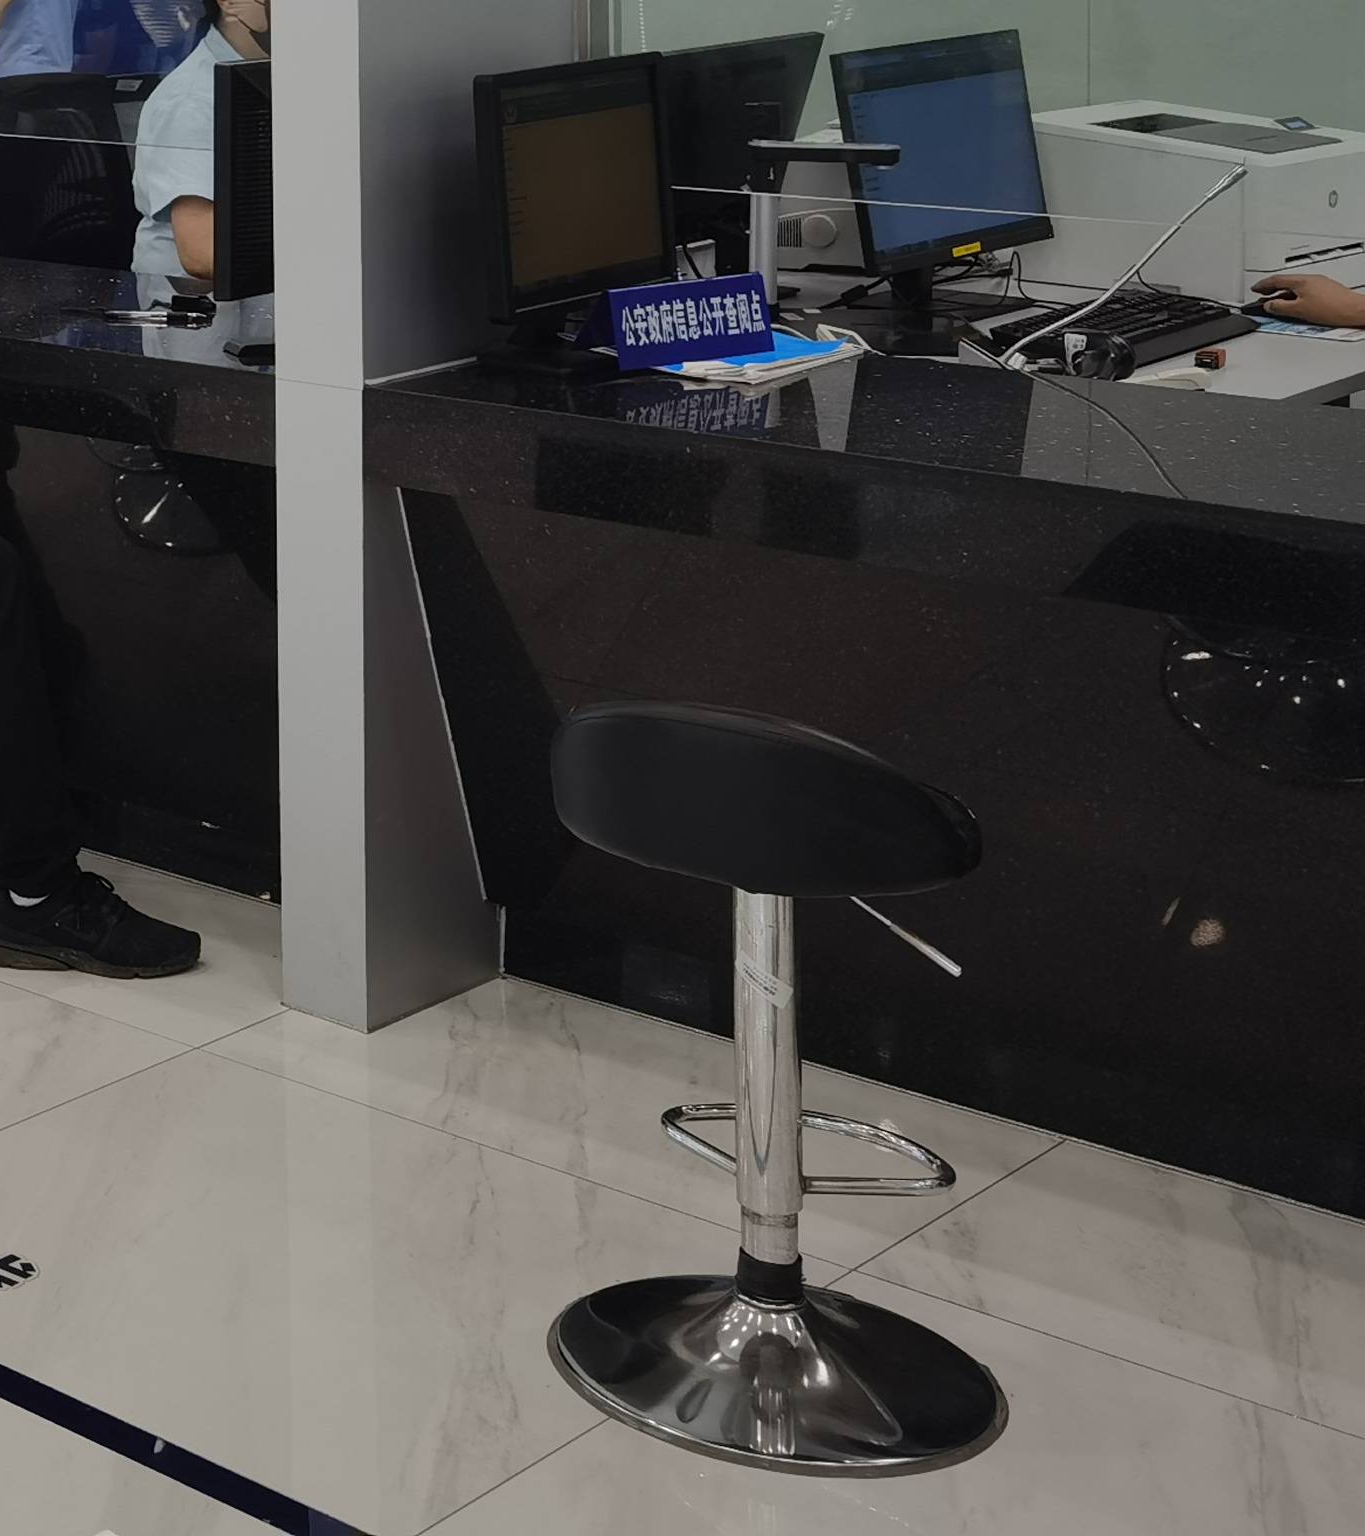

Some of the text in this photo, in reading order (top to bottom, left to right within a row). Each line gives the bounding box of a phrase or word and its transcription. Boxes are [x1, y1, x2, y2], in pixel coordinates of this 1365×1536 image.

[621, 290, 765, 347] 公安政府信息公开查阅点
